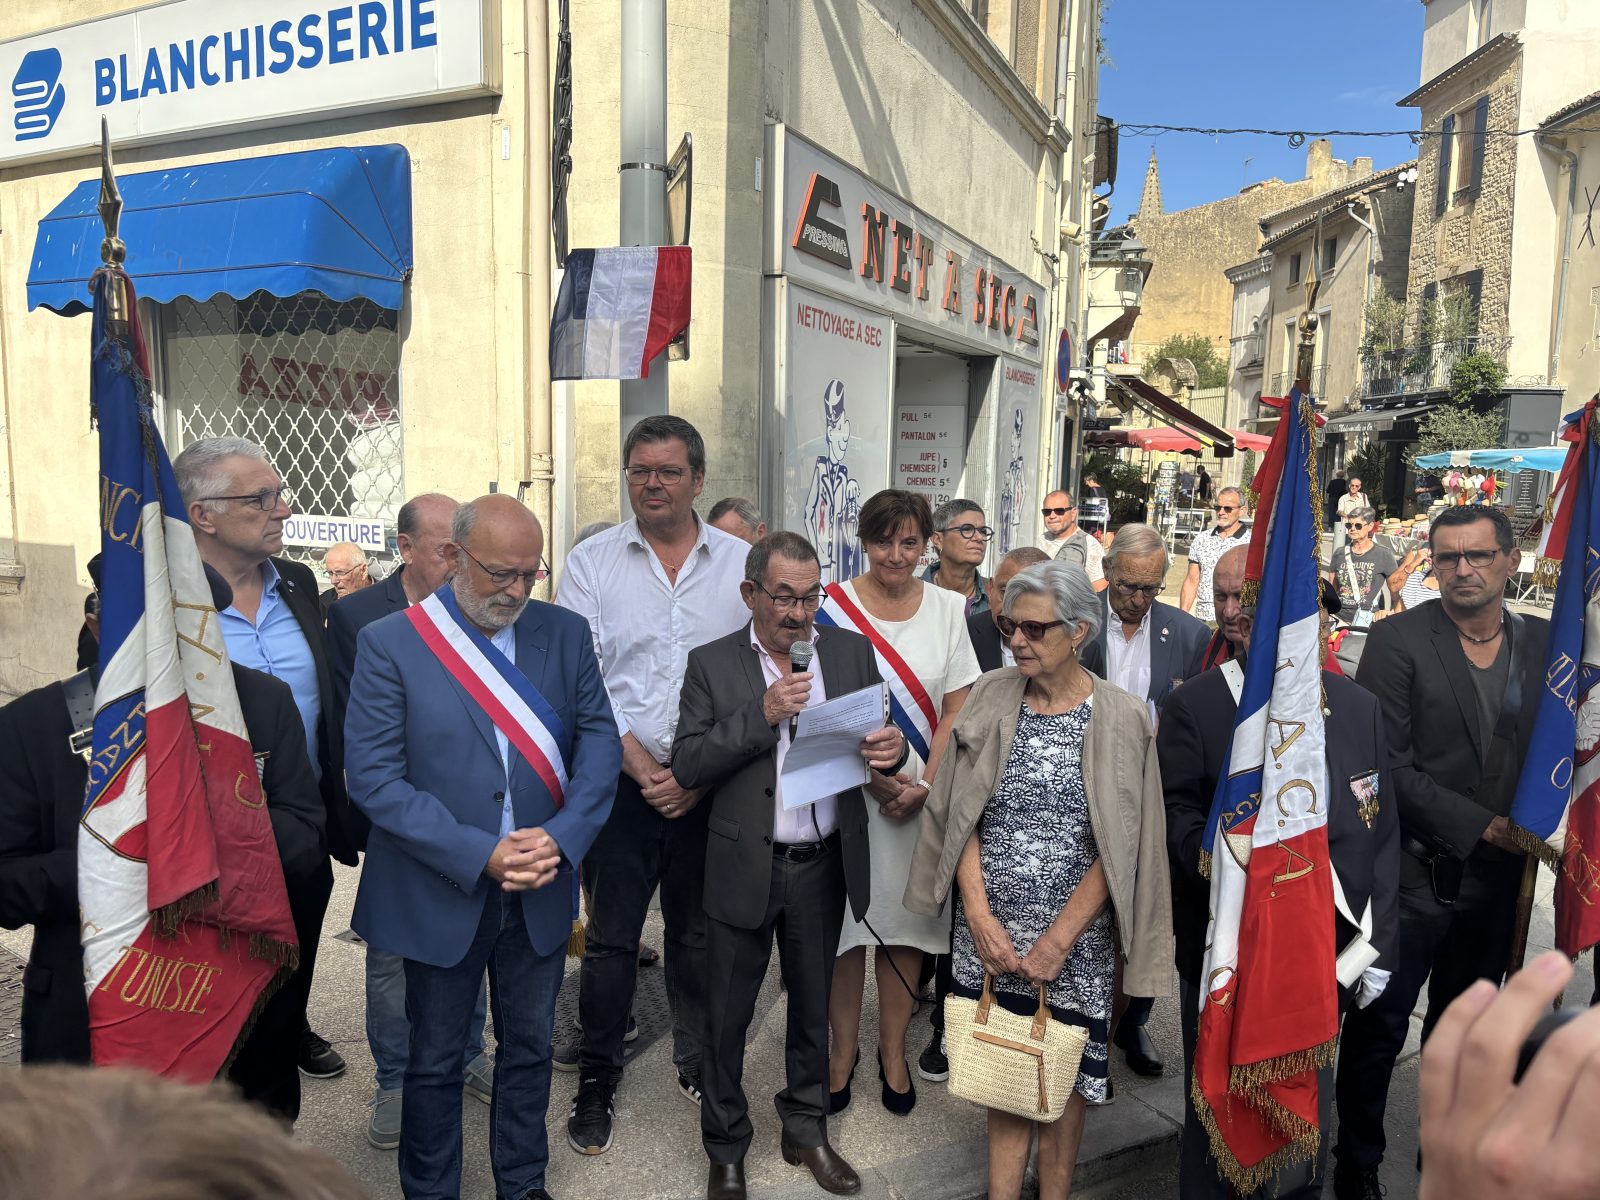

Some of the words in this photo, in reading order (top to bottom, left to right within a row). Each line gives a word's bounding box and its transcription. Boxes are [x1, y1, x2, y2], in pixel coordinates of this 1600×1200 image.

[94, 0, 437, 107] BLANCHISSERIE
[802, 223, 848, 257] PRESSING
[859, 201, 934, 301] NET
[943, 249, 962, 314] A
[973, 266, 1016, 336] SEC
[797, 302, 855, 341] NETTOYAGE
[856, 328, 863, 343] A
[864, 328, 882, 348] SEC
[1005, 366, 1036, 387] BLANCHISSERIE
[901, 412, 919, 422] PULL
[901, 431, 936, 441] PANTALON
[919, 452, 936, 462] JUPE
[900, 464, 936, 473] CHEMISIER
[906, 477, 936, 487] CHEMISE
[285, 520, 381, 544] OUVERTURE
[99, 945, 222, 1015] TUNISIE
